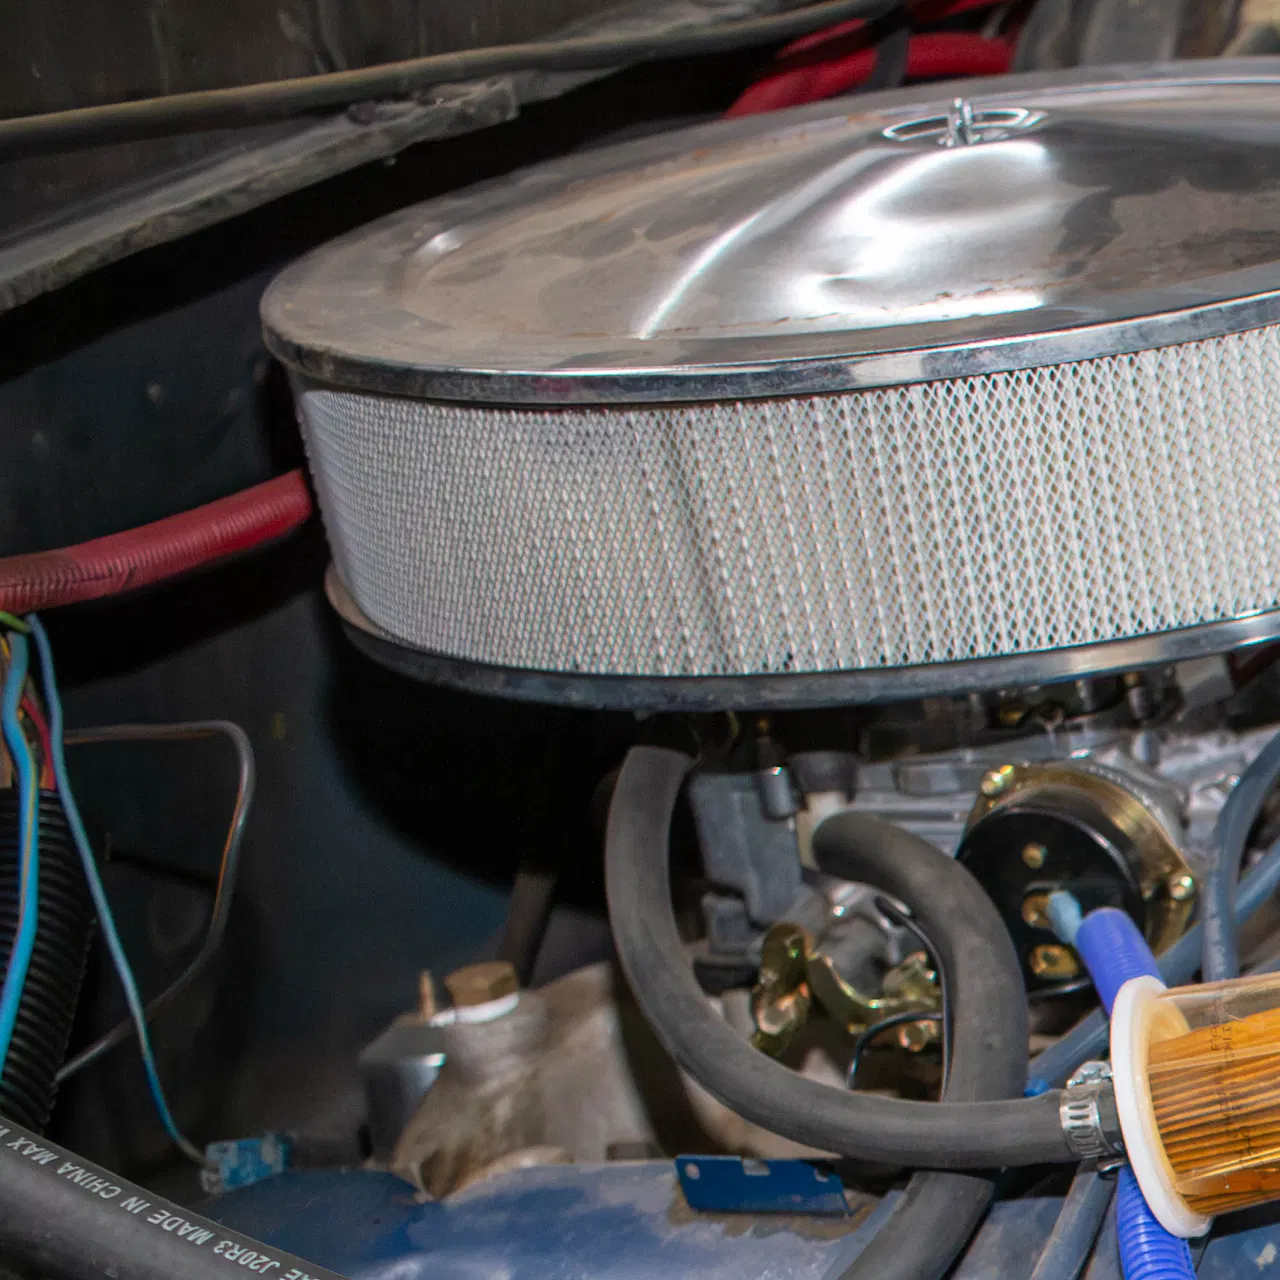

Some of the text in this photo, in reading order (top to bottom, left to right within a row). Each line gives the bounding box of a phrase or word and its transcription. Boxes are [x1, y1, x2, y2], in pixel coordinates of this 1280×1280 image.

[6, 1136, 59, 1166] MAX
[56, 1160, 123, 1199] CHINA
[119, 1195, 151, 1215] IN
[146, 1209, 216, 1245] MADE
[212, 1239, 281, 1275] J20R3
